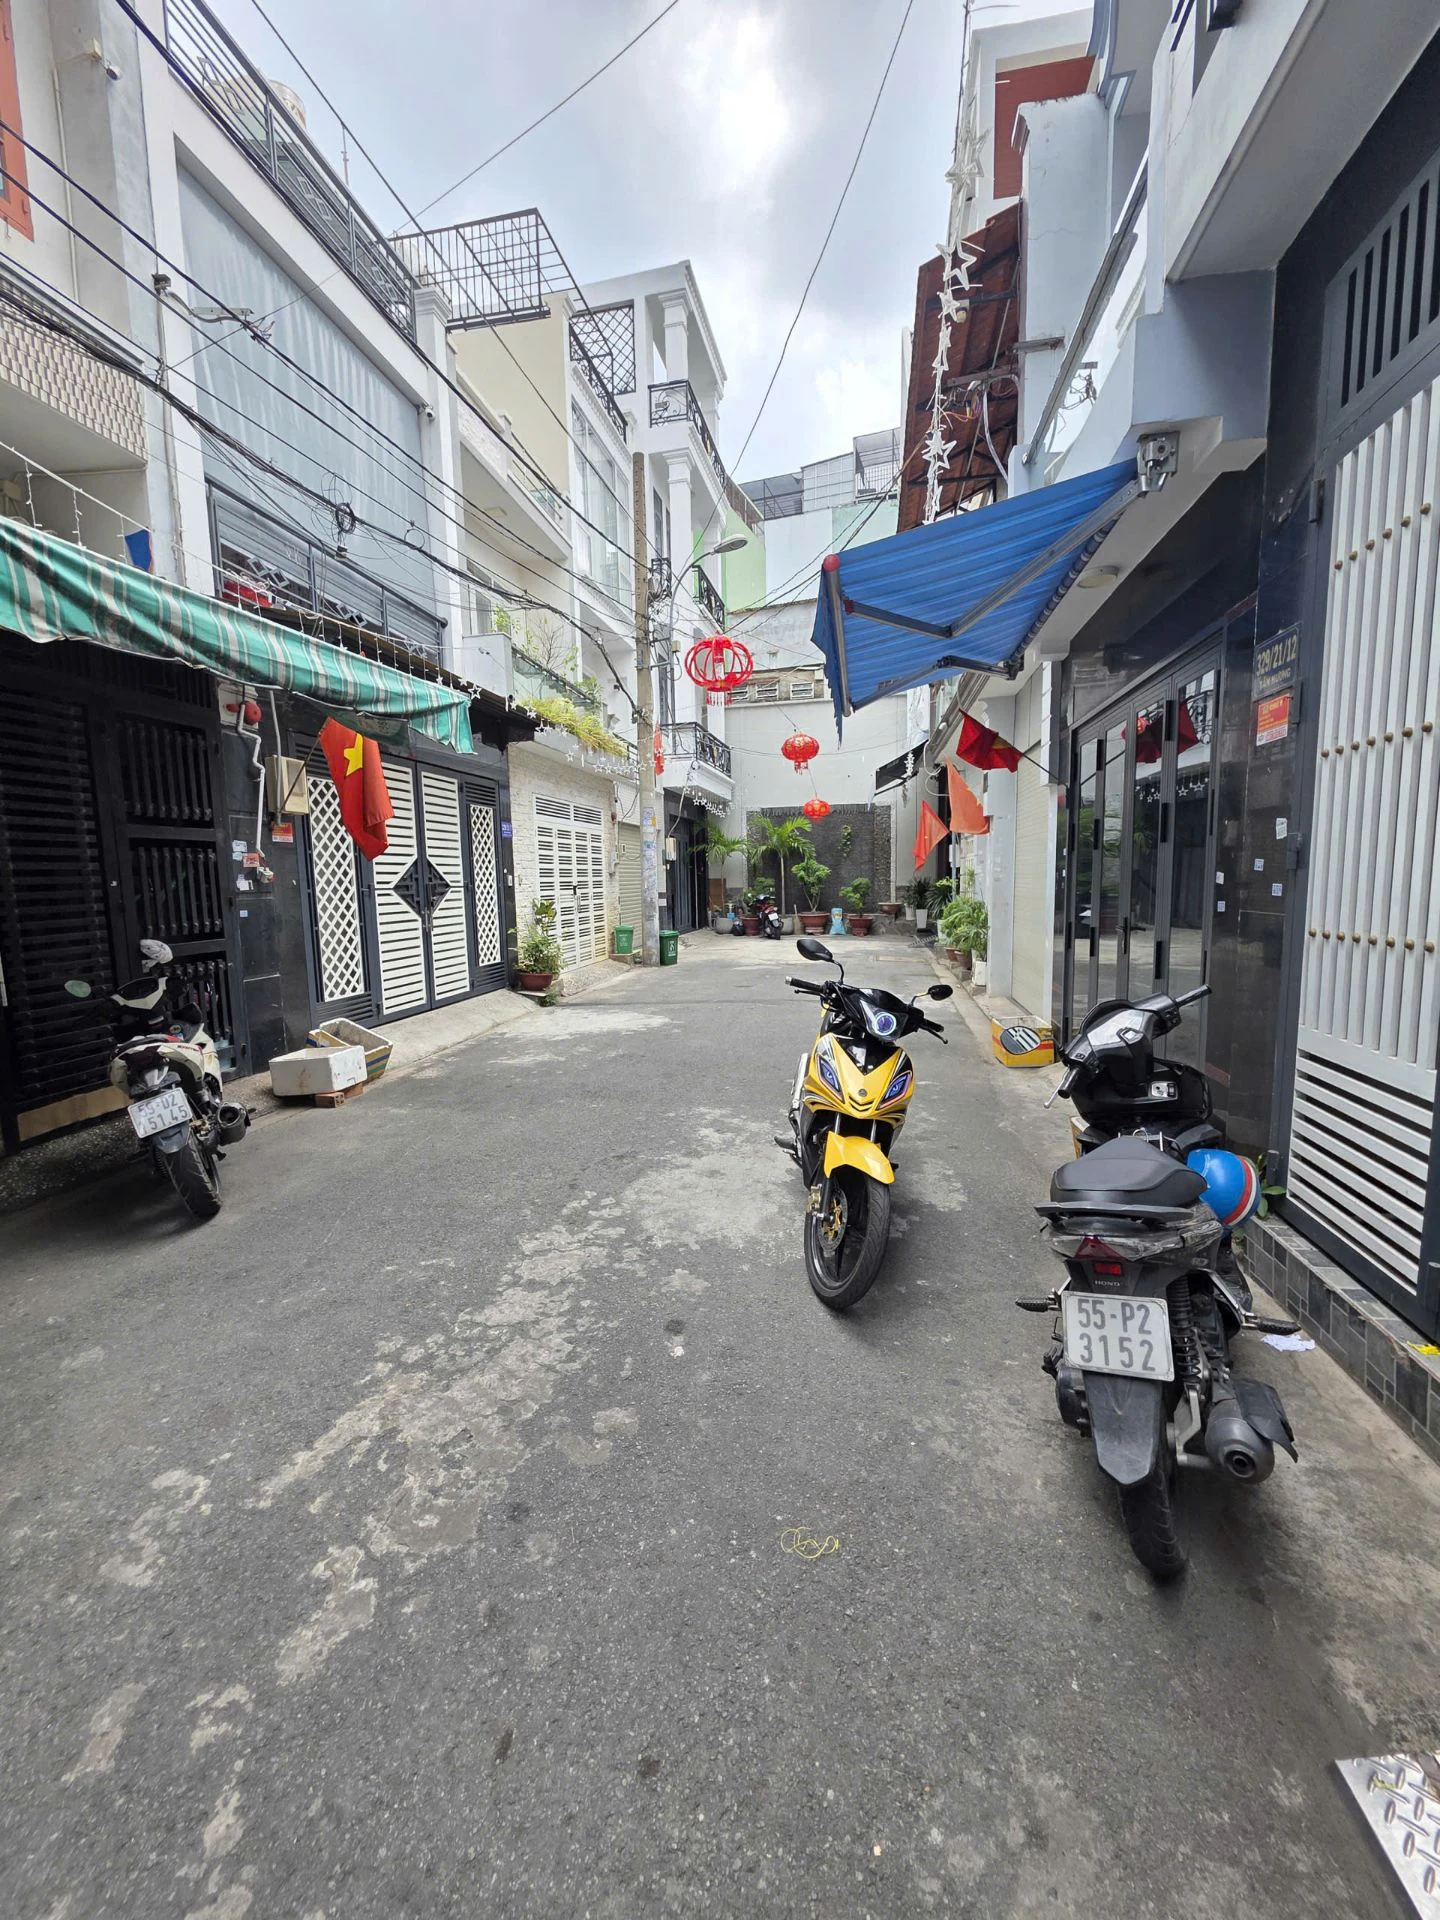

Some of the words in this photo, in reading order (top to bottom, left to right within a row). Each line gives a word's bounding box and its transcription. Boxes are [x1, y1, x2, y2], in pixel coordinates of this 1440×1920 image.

[1256, 634, 1297, 677] 329/21/12
[1077, 1298, 1152, 1335] 55-P2
[1079, 1332, 1156, 1372] 3152
